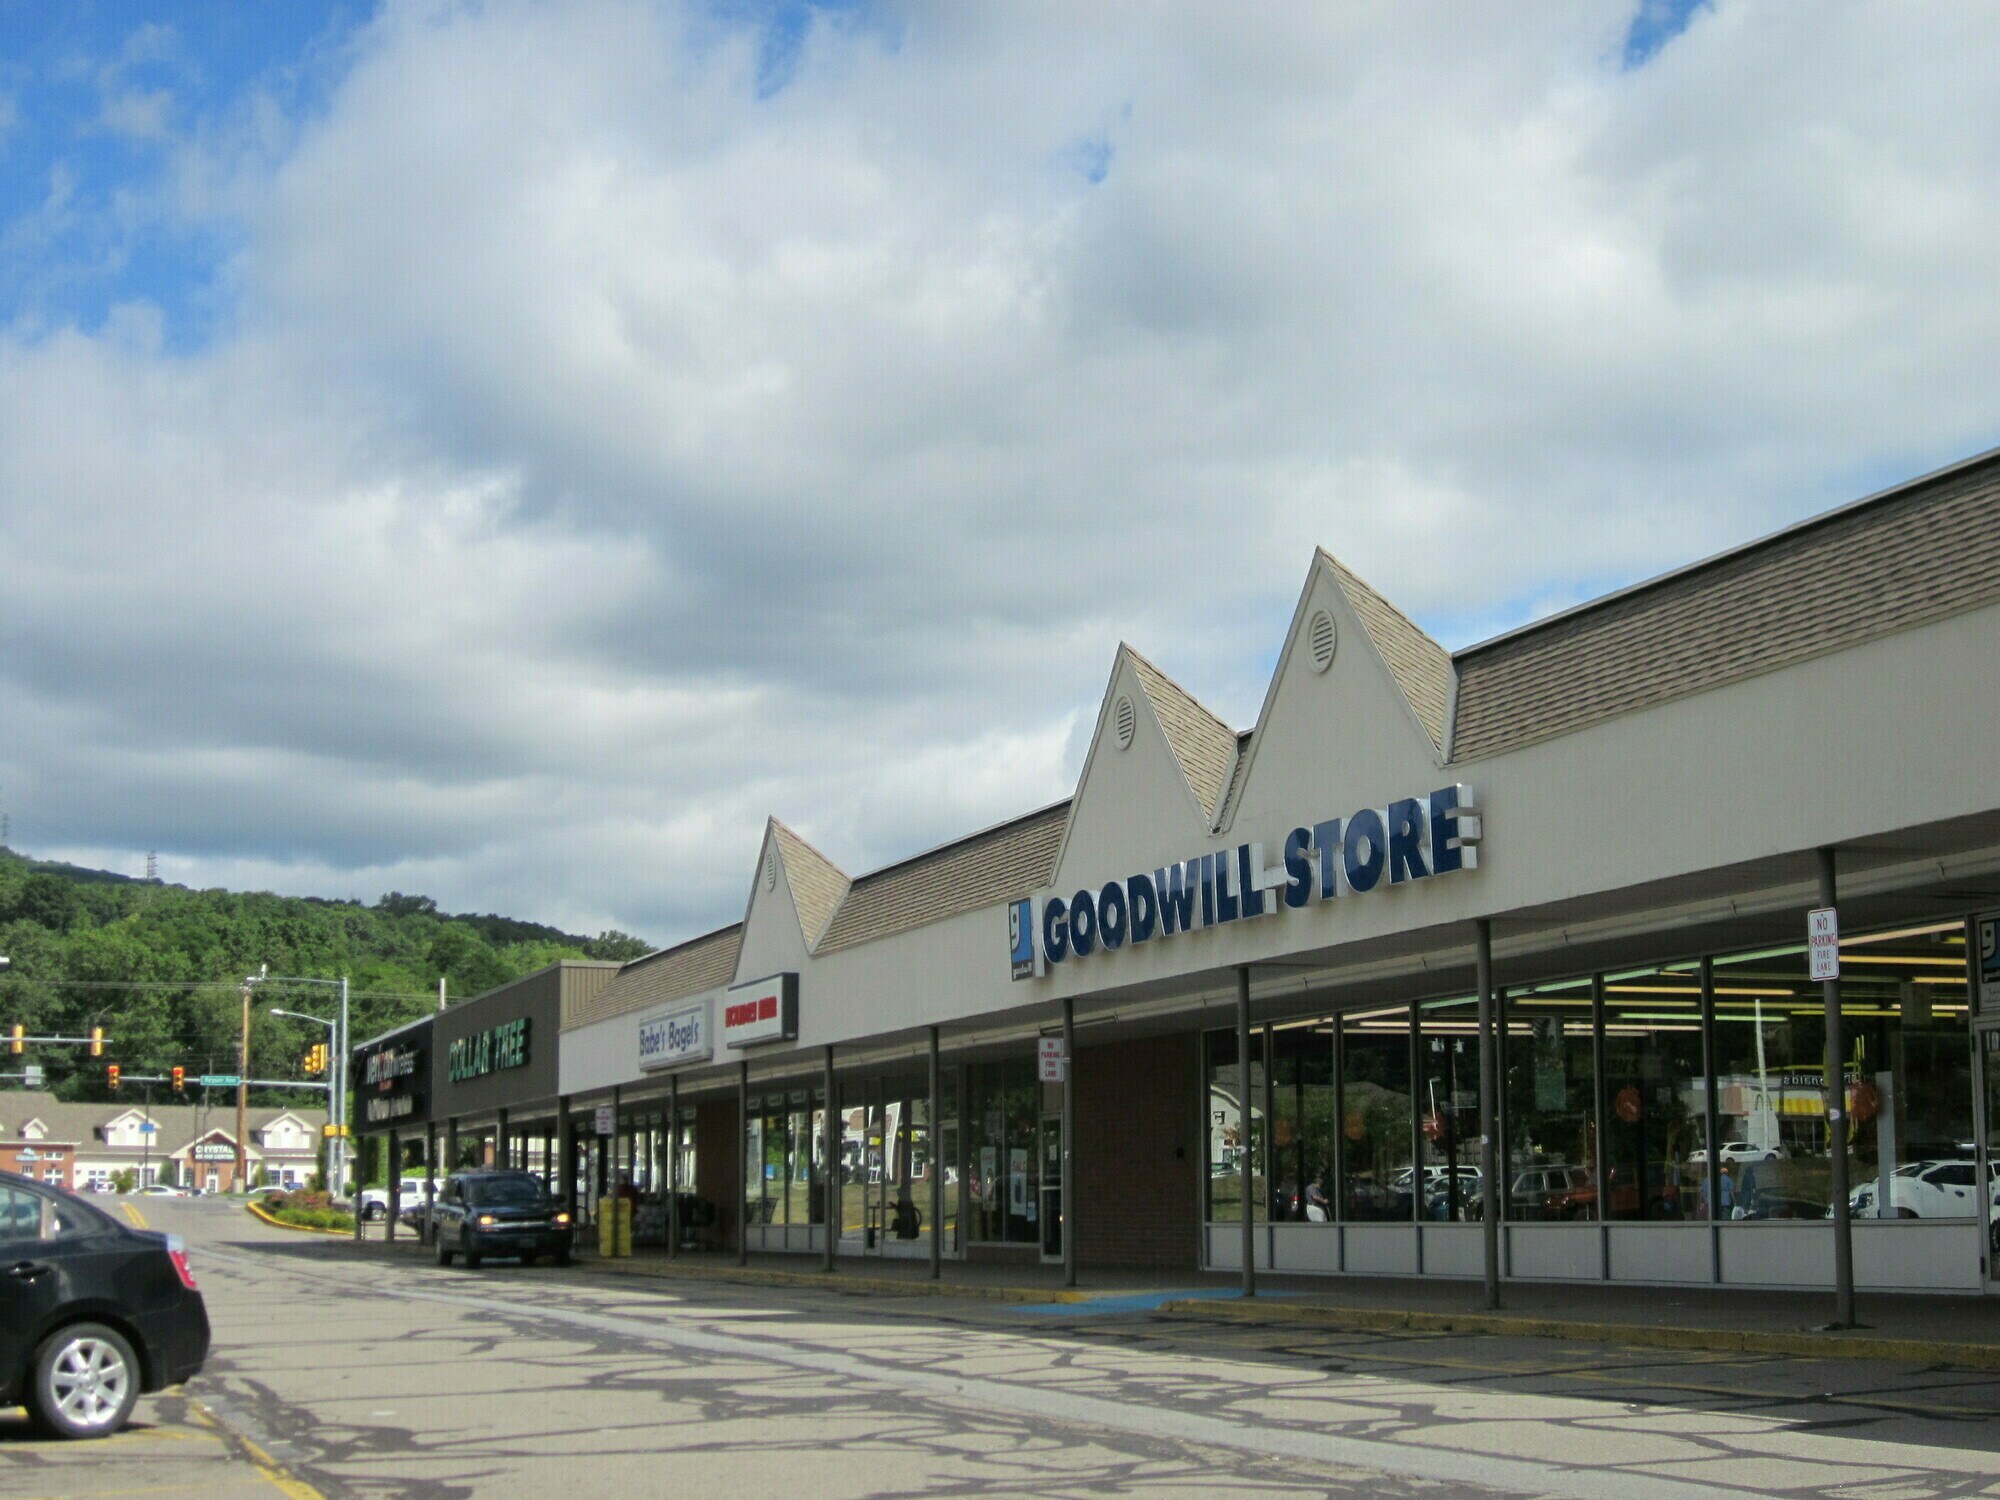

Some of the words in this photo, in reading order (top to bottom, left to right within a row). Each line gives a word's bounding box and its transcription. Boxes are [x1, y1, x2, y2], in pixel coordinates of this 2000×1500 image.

[1043, 844, 1271, 964] GOODWILL
[1284, 784, 1472, 907] STORE
[1816, 917, 1828, 931] NO
[1811, 932, 1836, 948] PARKING
[1817, 949, 1830, 959] FIRE
[1816, 961, 1832, 972] LANE
[640, 1024, 665, 1056] Babe's
[669, 1015, 699, 1052] Bagels
[448, 1030, 490, 1082] DOLLAR
[495, 1018, 527, 1070] TREE
